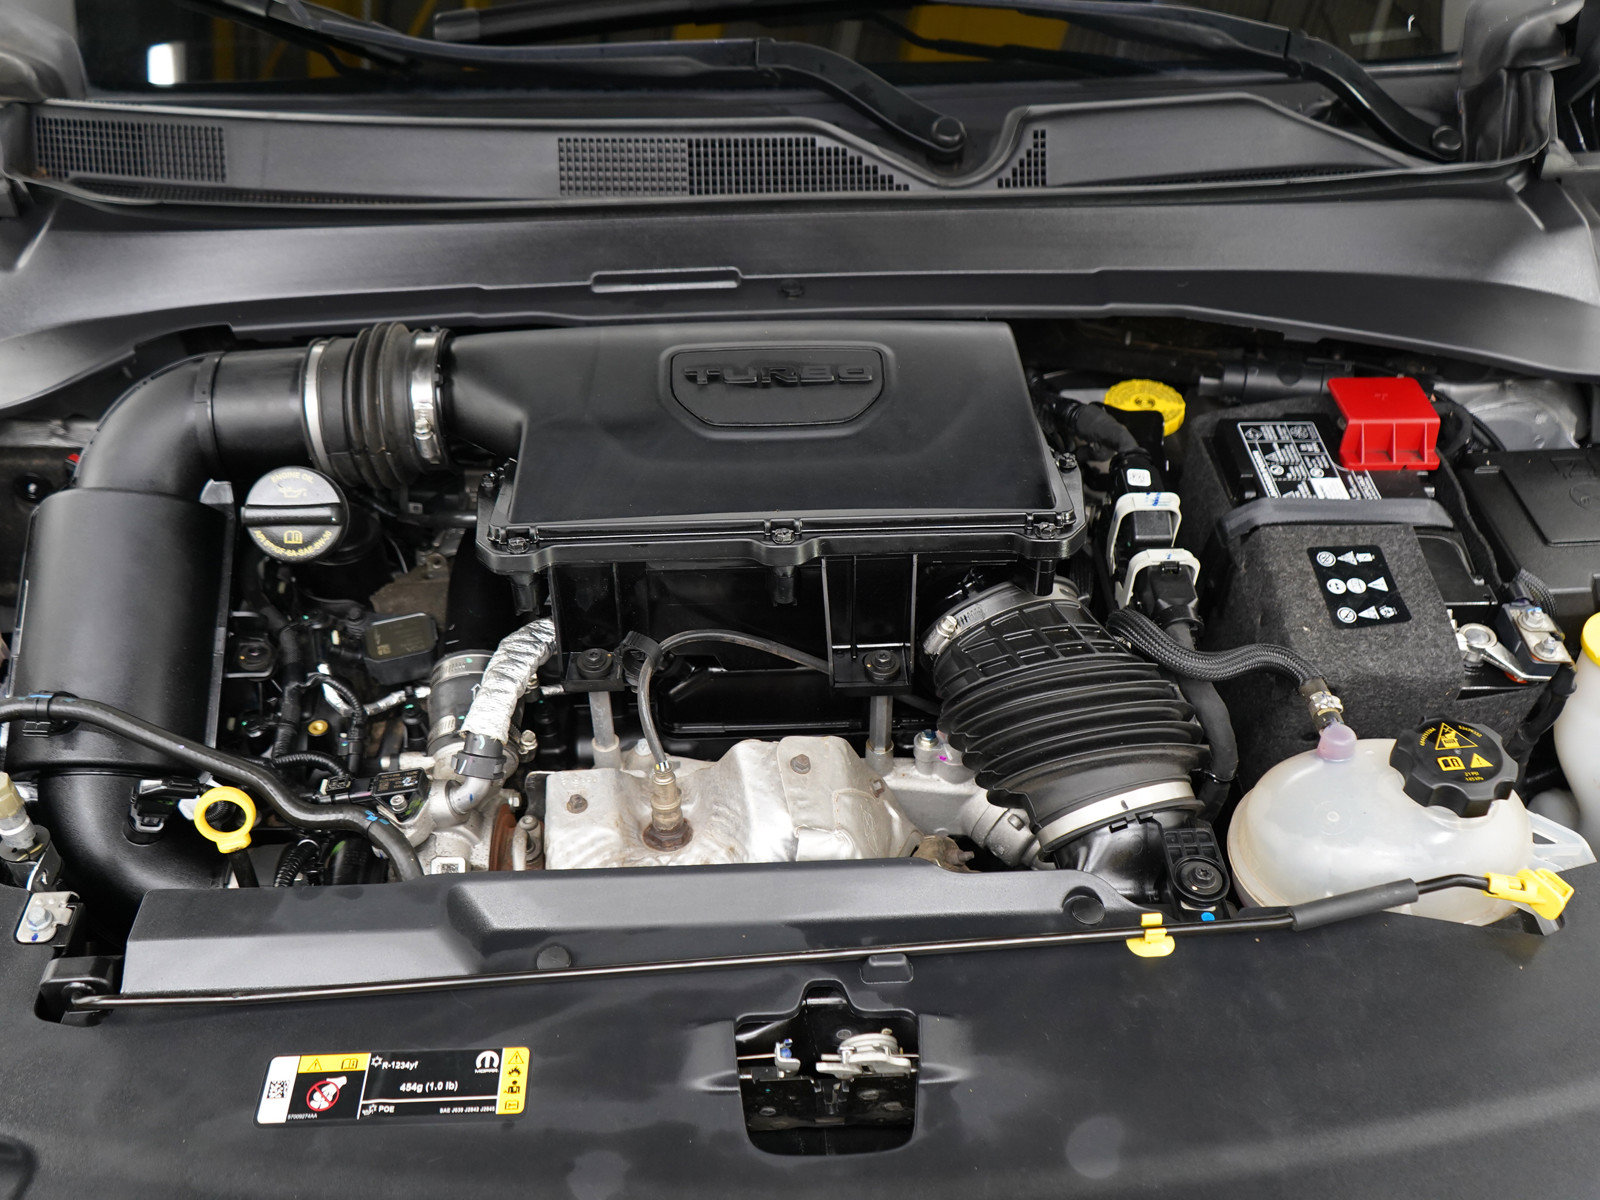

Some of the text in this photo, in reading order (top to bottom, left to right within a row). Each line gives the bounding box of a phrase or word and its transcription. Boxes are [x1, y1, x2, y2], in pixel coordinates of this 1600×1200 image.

[684, 365, 873, 387] TURBO
[270, 471, 314, 484] ENGINE OIL
[381, 1061, 419, 1071] R-1234yf
[400, 1081, 458, 1094] 454g (1.0 lb)
[378, 1105, 395, 1113] POE
